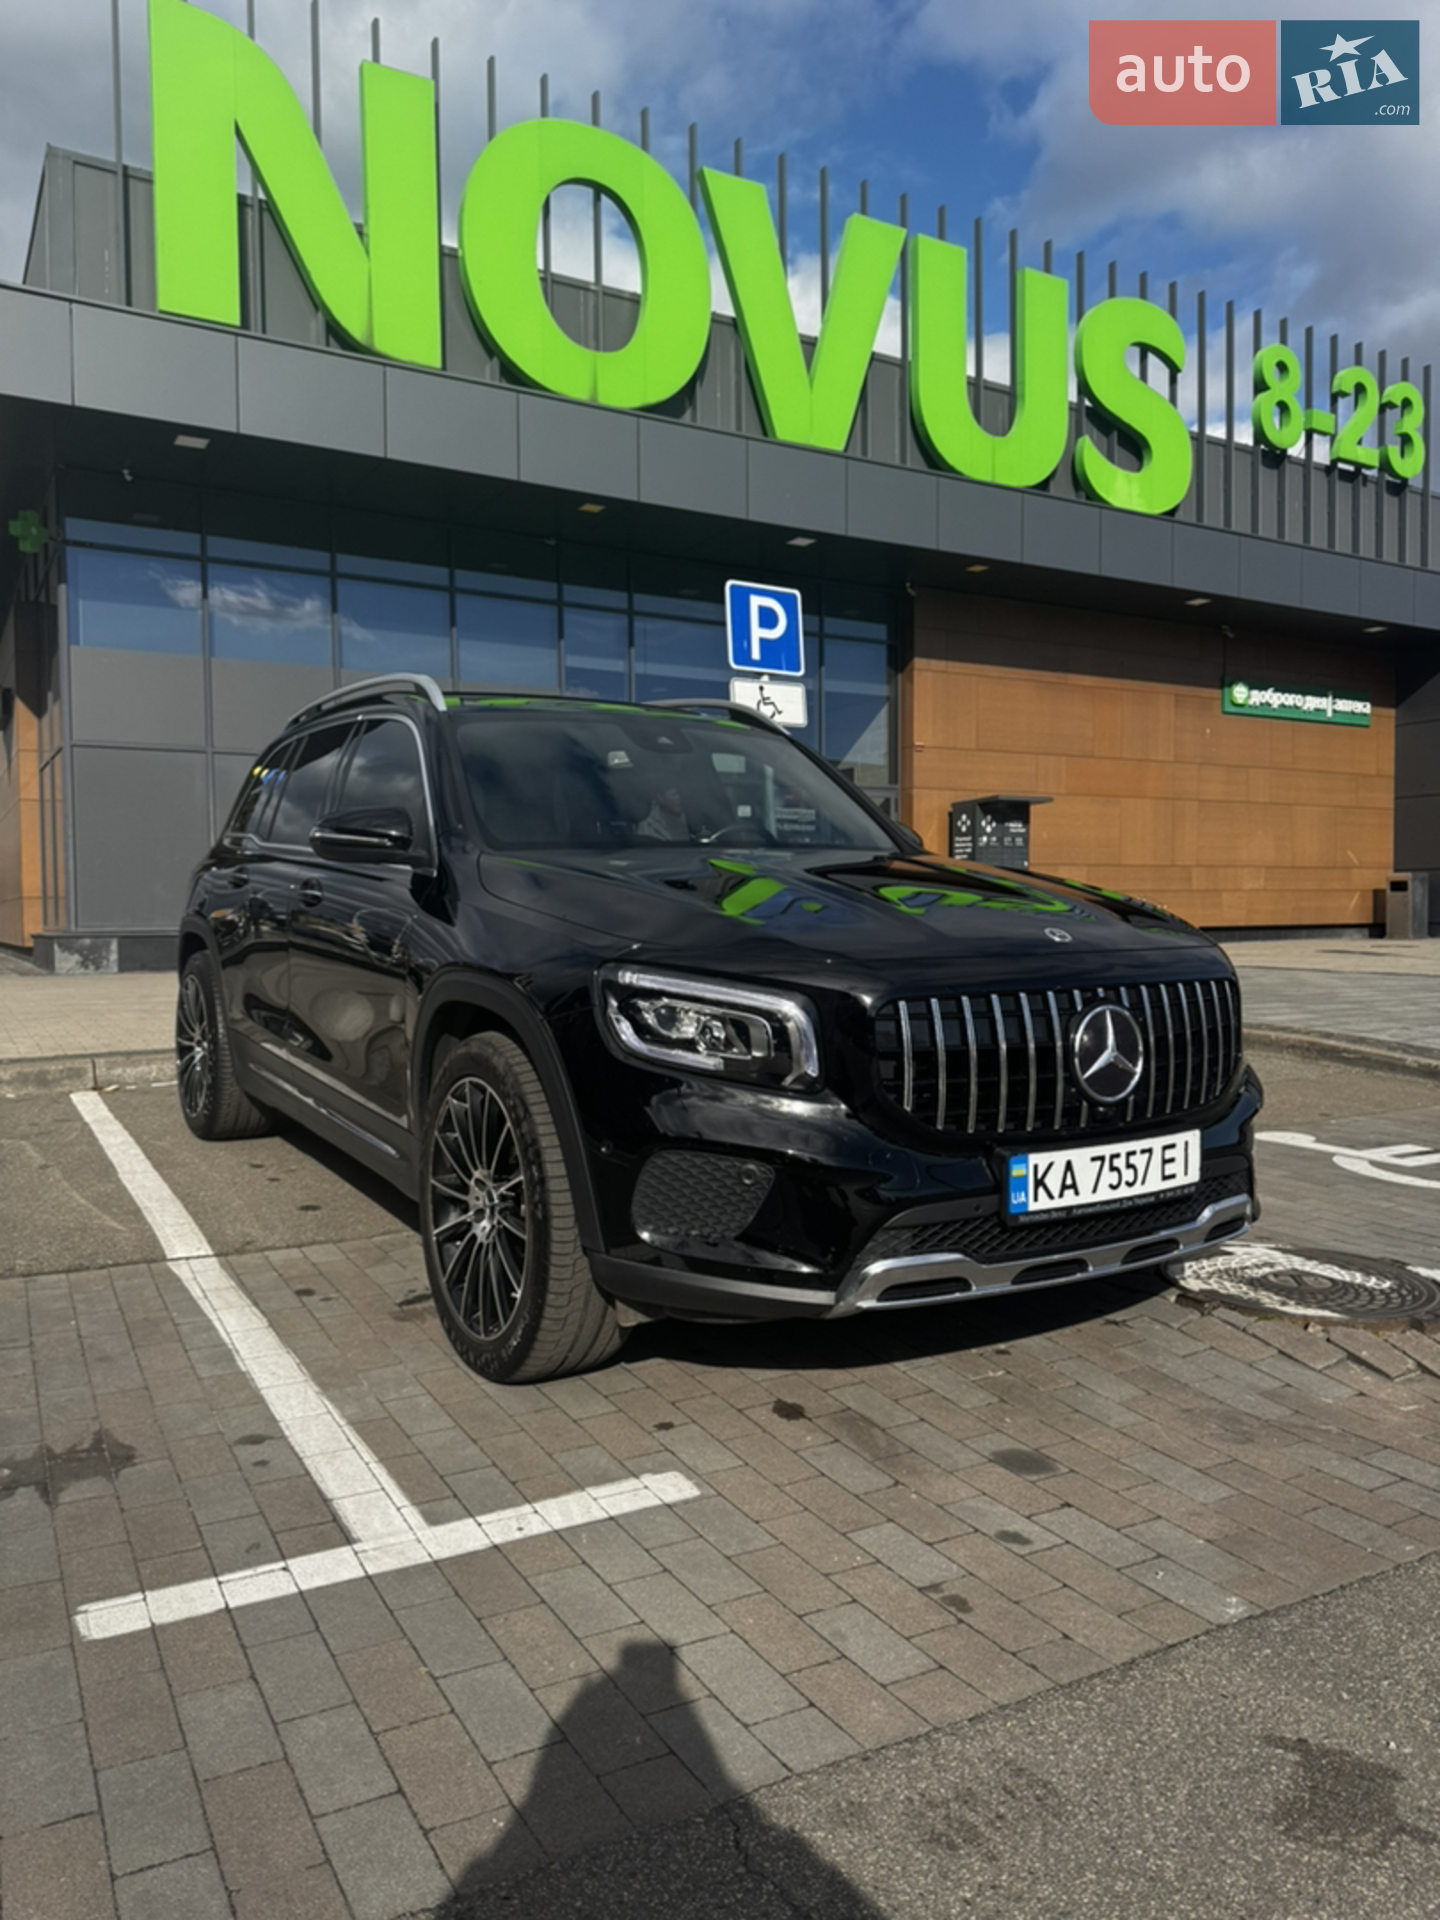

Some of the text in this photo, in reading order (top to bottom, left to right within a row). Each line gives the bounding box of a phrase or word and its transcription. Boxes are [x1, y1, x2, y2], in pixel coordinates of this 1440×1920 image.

[148, 0, 1193, 516] NOVUS
[1253, 343, 1425, 479] 8-23
[749, 594, 787, 661] P
[1248, 688, 1303, 711] доброго
[1011, 1191, 1027, 1205] UA
[1033, 1140, 1189, 1202] KA 7557 EI
